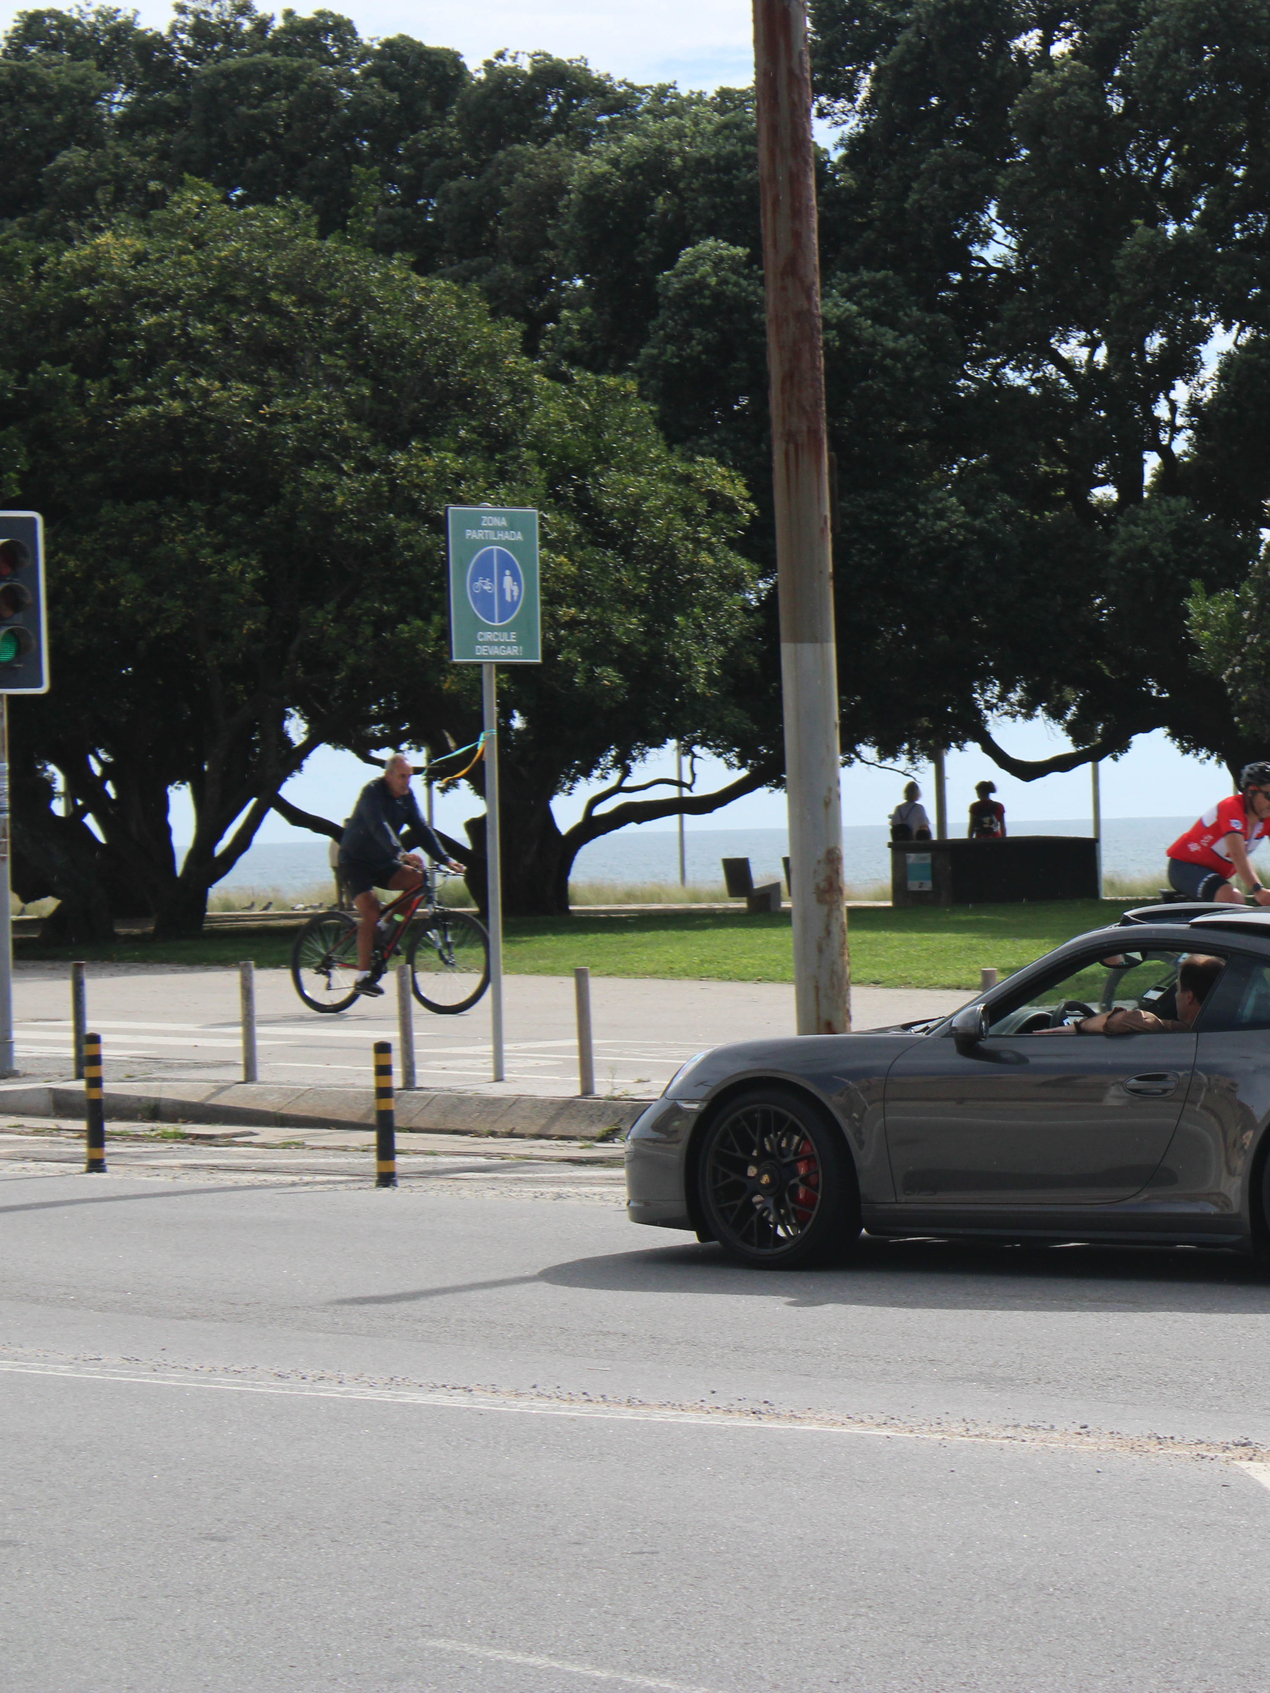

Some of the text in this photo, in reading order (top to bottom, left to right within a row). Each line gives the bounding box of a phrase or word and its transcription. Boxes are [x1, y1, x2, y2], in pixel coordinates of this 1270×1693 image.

[481, 516, 507, 527] ZONA
[465, 529, 524, 541] PARTILHADA
[477, 632, 517, 642] CIRCULE
[475, 645, 523, 656] DEVAGAR!
